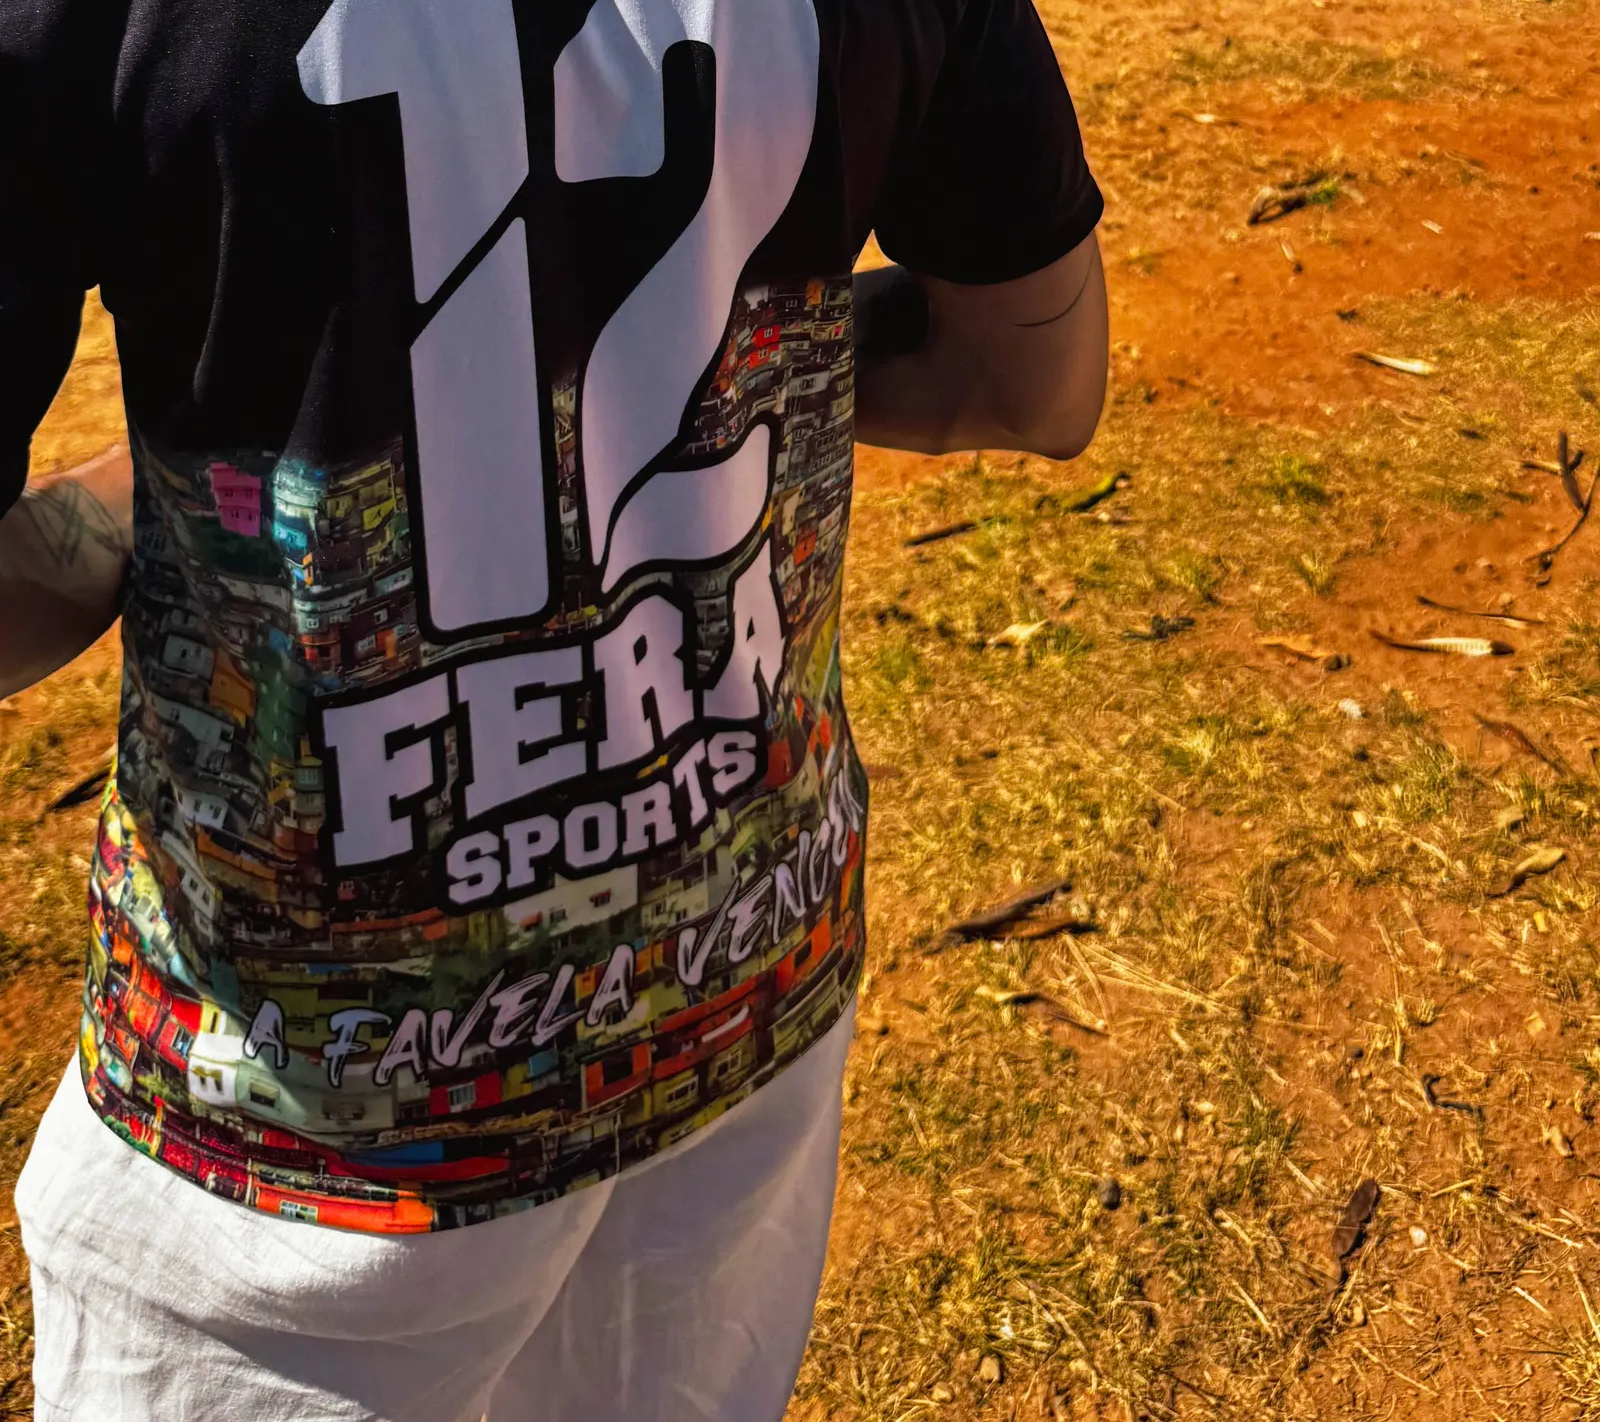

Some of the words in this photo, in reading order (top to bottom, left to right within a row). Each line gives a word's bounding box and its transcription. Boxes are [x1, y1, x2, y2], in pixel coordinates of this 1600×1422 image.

[322, 537, 787, 868] FERA
[445, 730, 758, 905] SPORTS
[244, 1000, 289, 1068] A
[322, 943, 637, 1088] FAVELA
